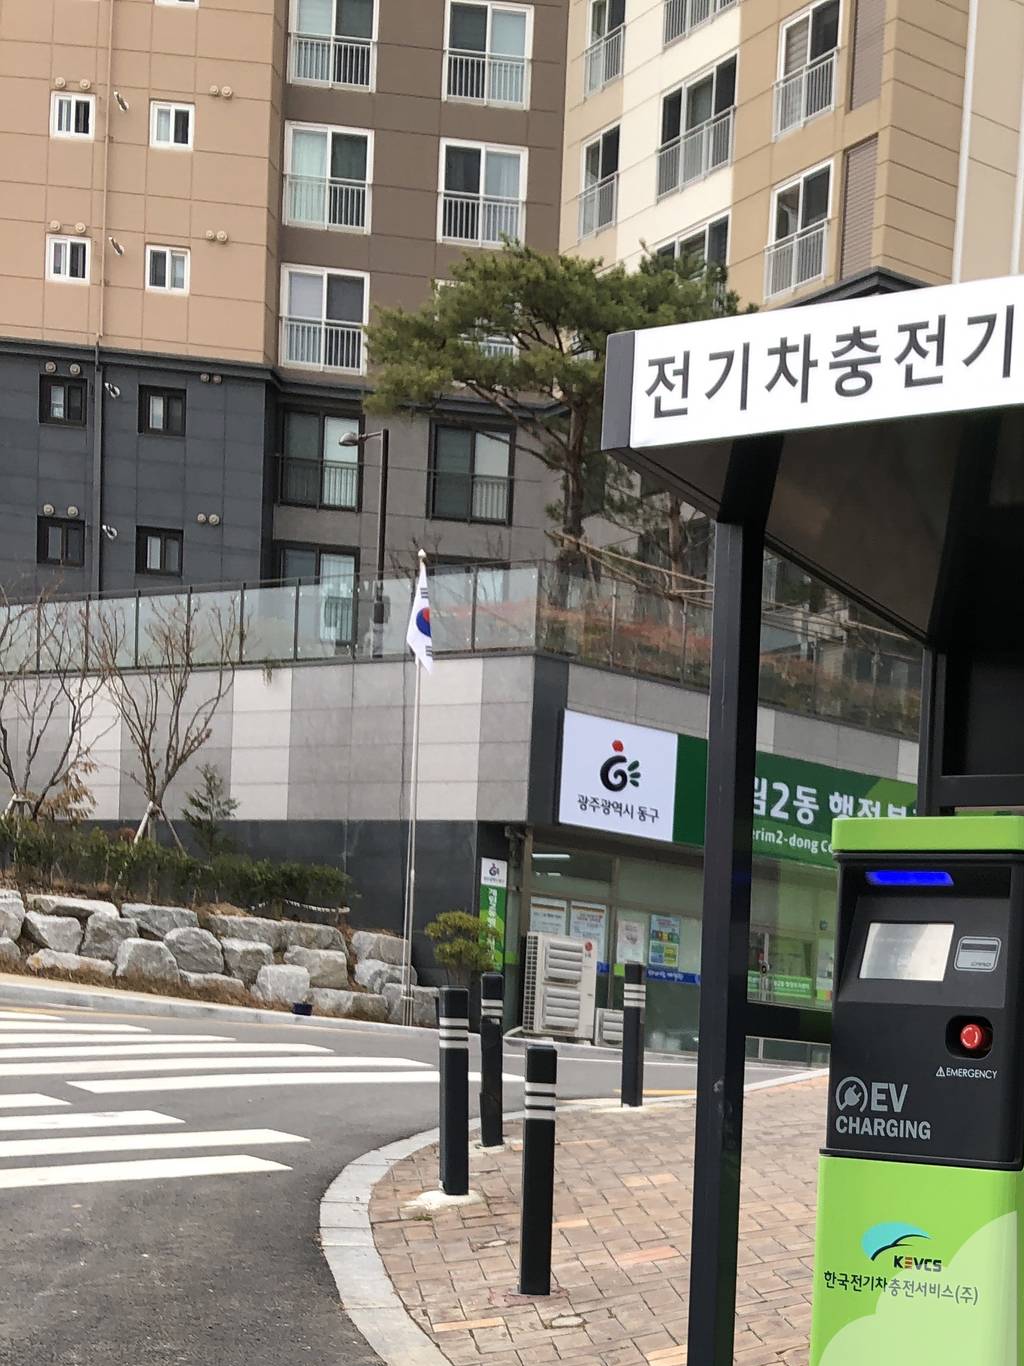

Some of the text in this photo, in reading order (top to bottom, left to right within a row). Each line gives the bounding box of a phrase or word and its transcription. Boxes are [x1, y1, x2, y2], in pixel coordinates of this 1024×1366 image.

[645, 304, 1015, 419] 전기차충전기
[578, 794, 659, 823] 광주광역시 동구
[946, 1067, 997, 1079] EMERGENCY
[871, 1082, 908, 1112] EV
[836, 1115, 931, 1140] CHARGING
[894, 1255, 942, 1273] KEVCS
[824, 1270, 979, 1305] 한국전기차충전서비스(주)
